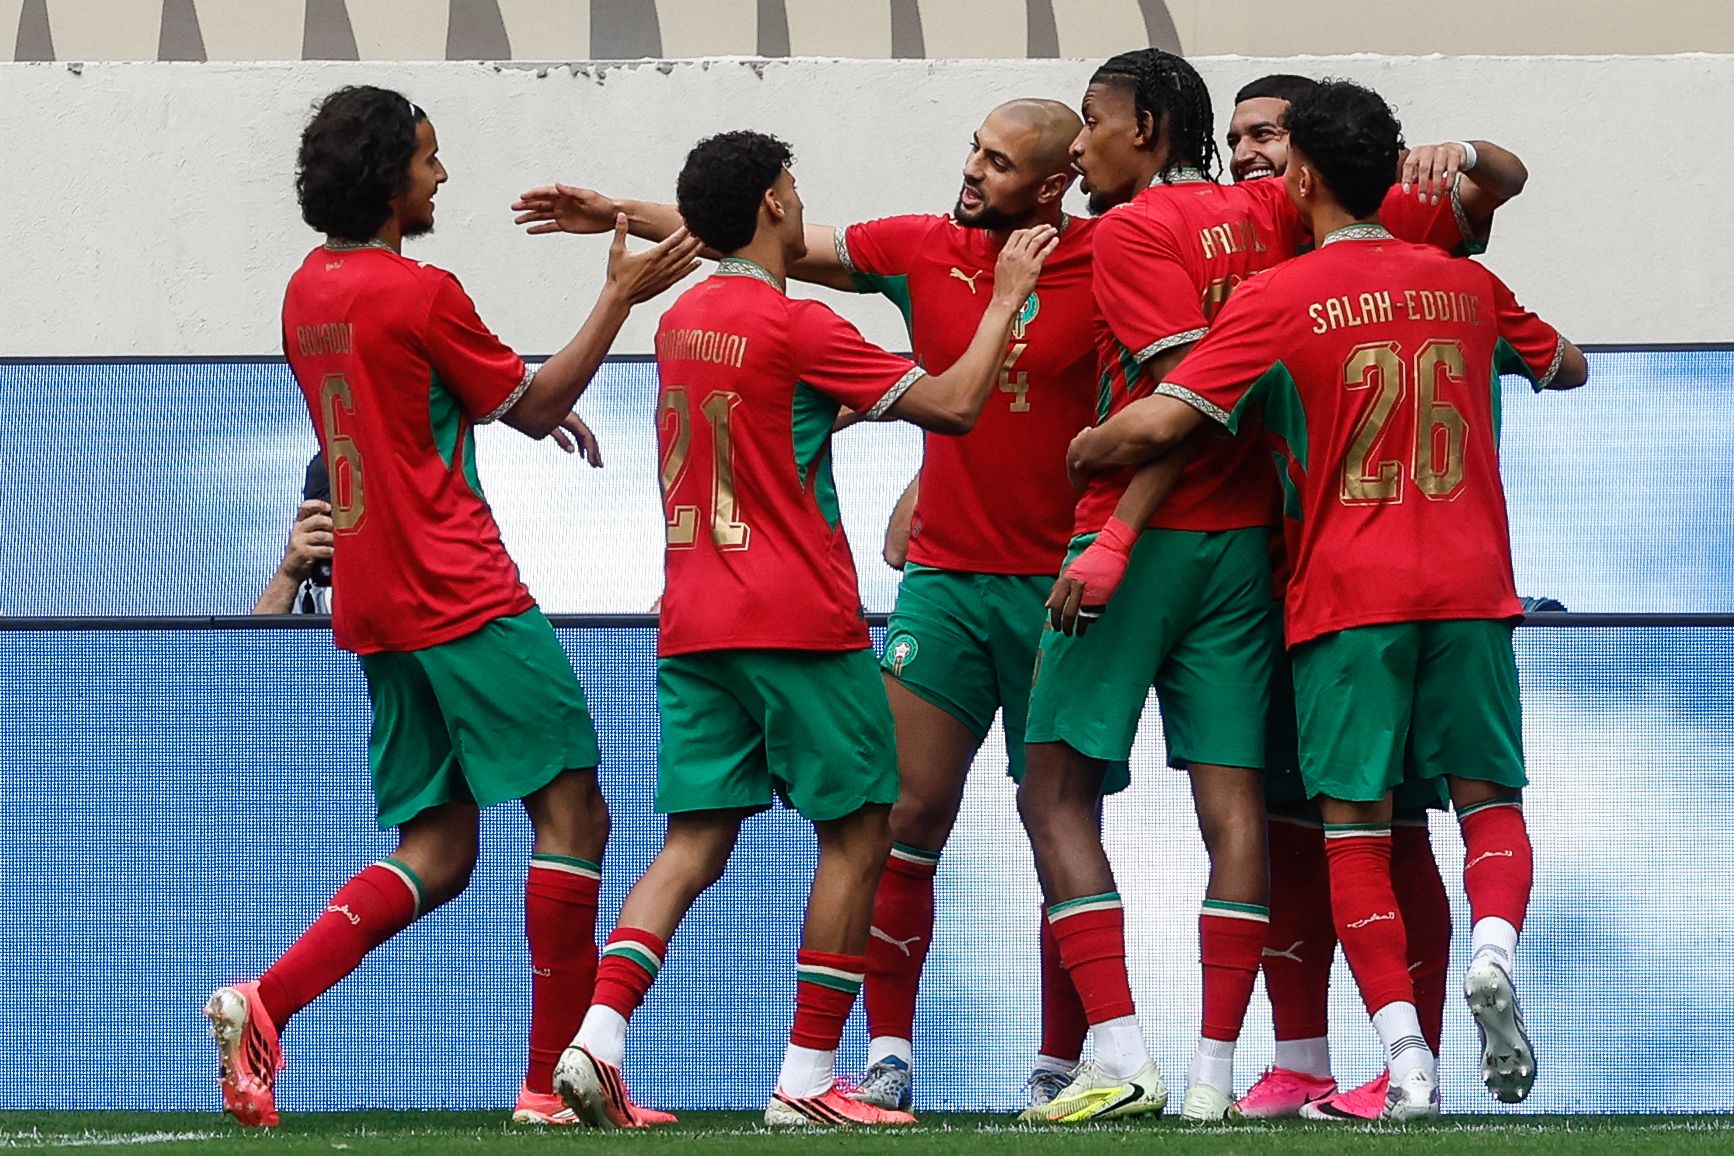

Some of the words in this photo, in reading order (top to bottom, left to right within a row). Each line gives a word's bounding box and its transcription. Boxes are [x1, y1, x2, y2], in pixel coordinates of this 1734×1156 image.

[998, 343, 1031, 412] 4
[1309, 289, 1480, 334] SALAH-EDDINE
[319, 372, 368, 537] 6
[657, 384, 751, 552] 21
[1339, 338, 1469, 507] 26
